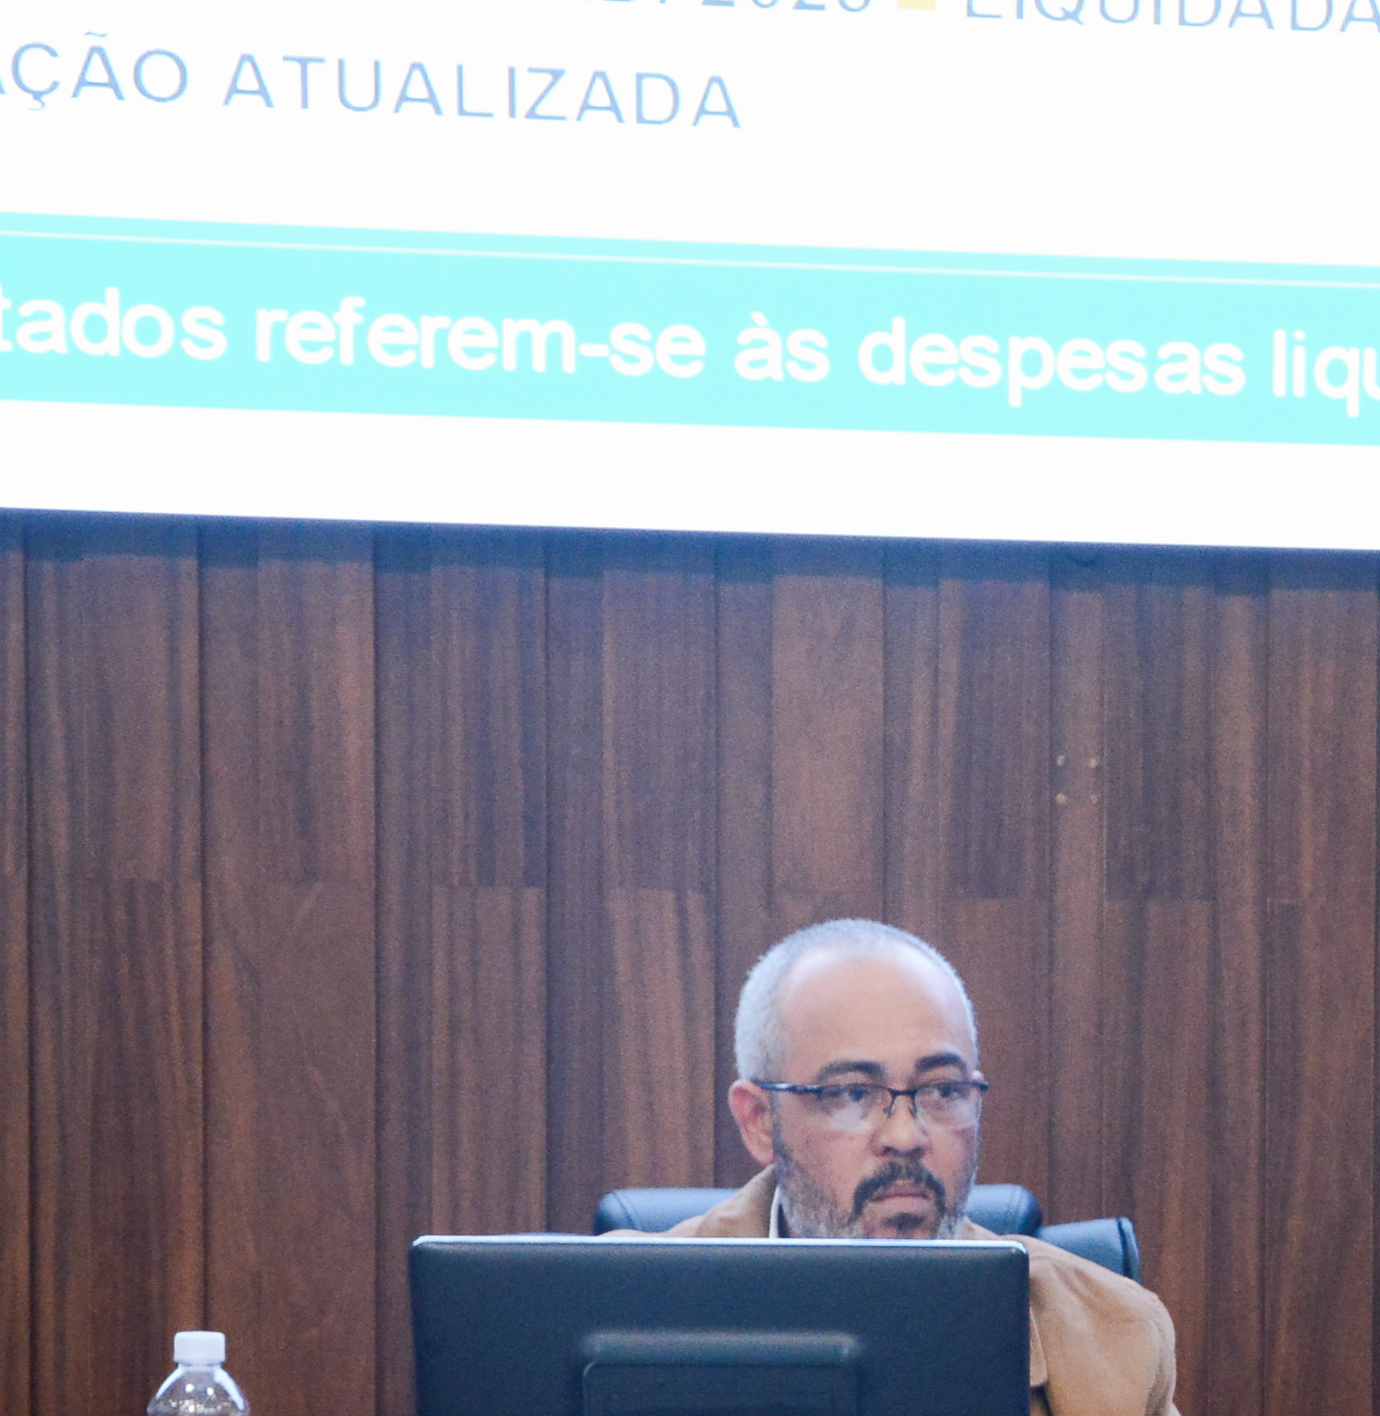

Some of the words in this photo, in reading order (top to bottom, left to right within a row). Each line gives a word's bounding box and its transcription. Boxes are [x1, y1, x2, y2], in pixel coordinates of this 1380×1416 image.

[0, 32, 189, 110] ÇÃO
[223, 53, 741, 128] ATUALIZADA
[256, 296, 706, 378] referem-se
[734, 312, 830, 382] às
[858, 317, 1246, 407] despesas
